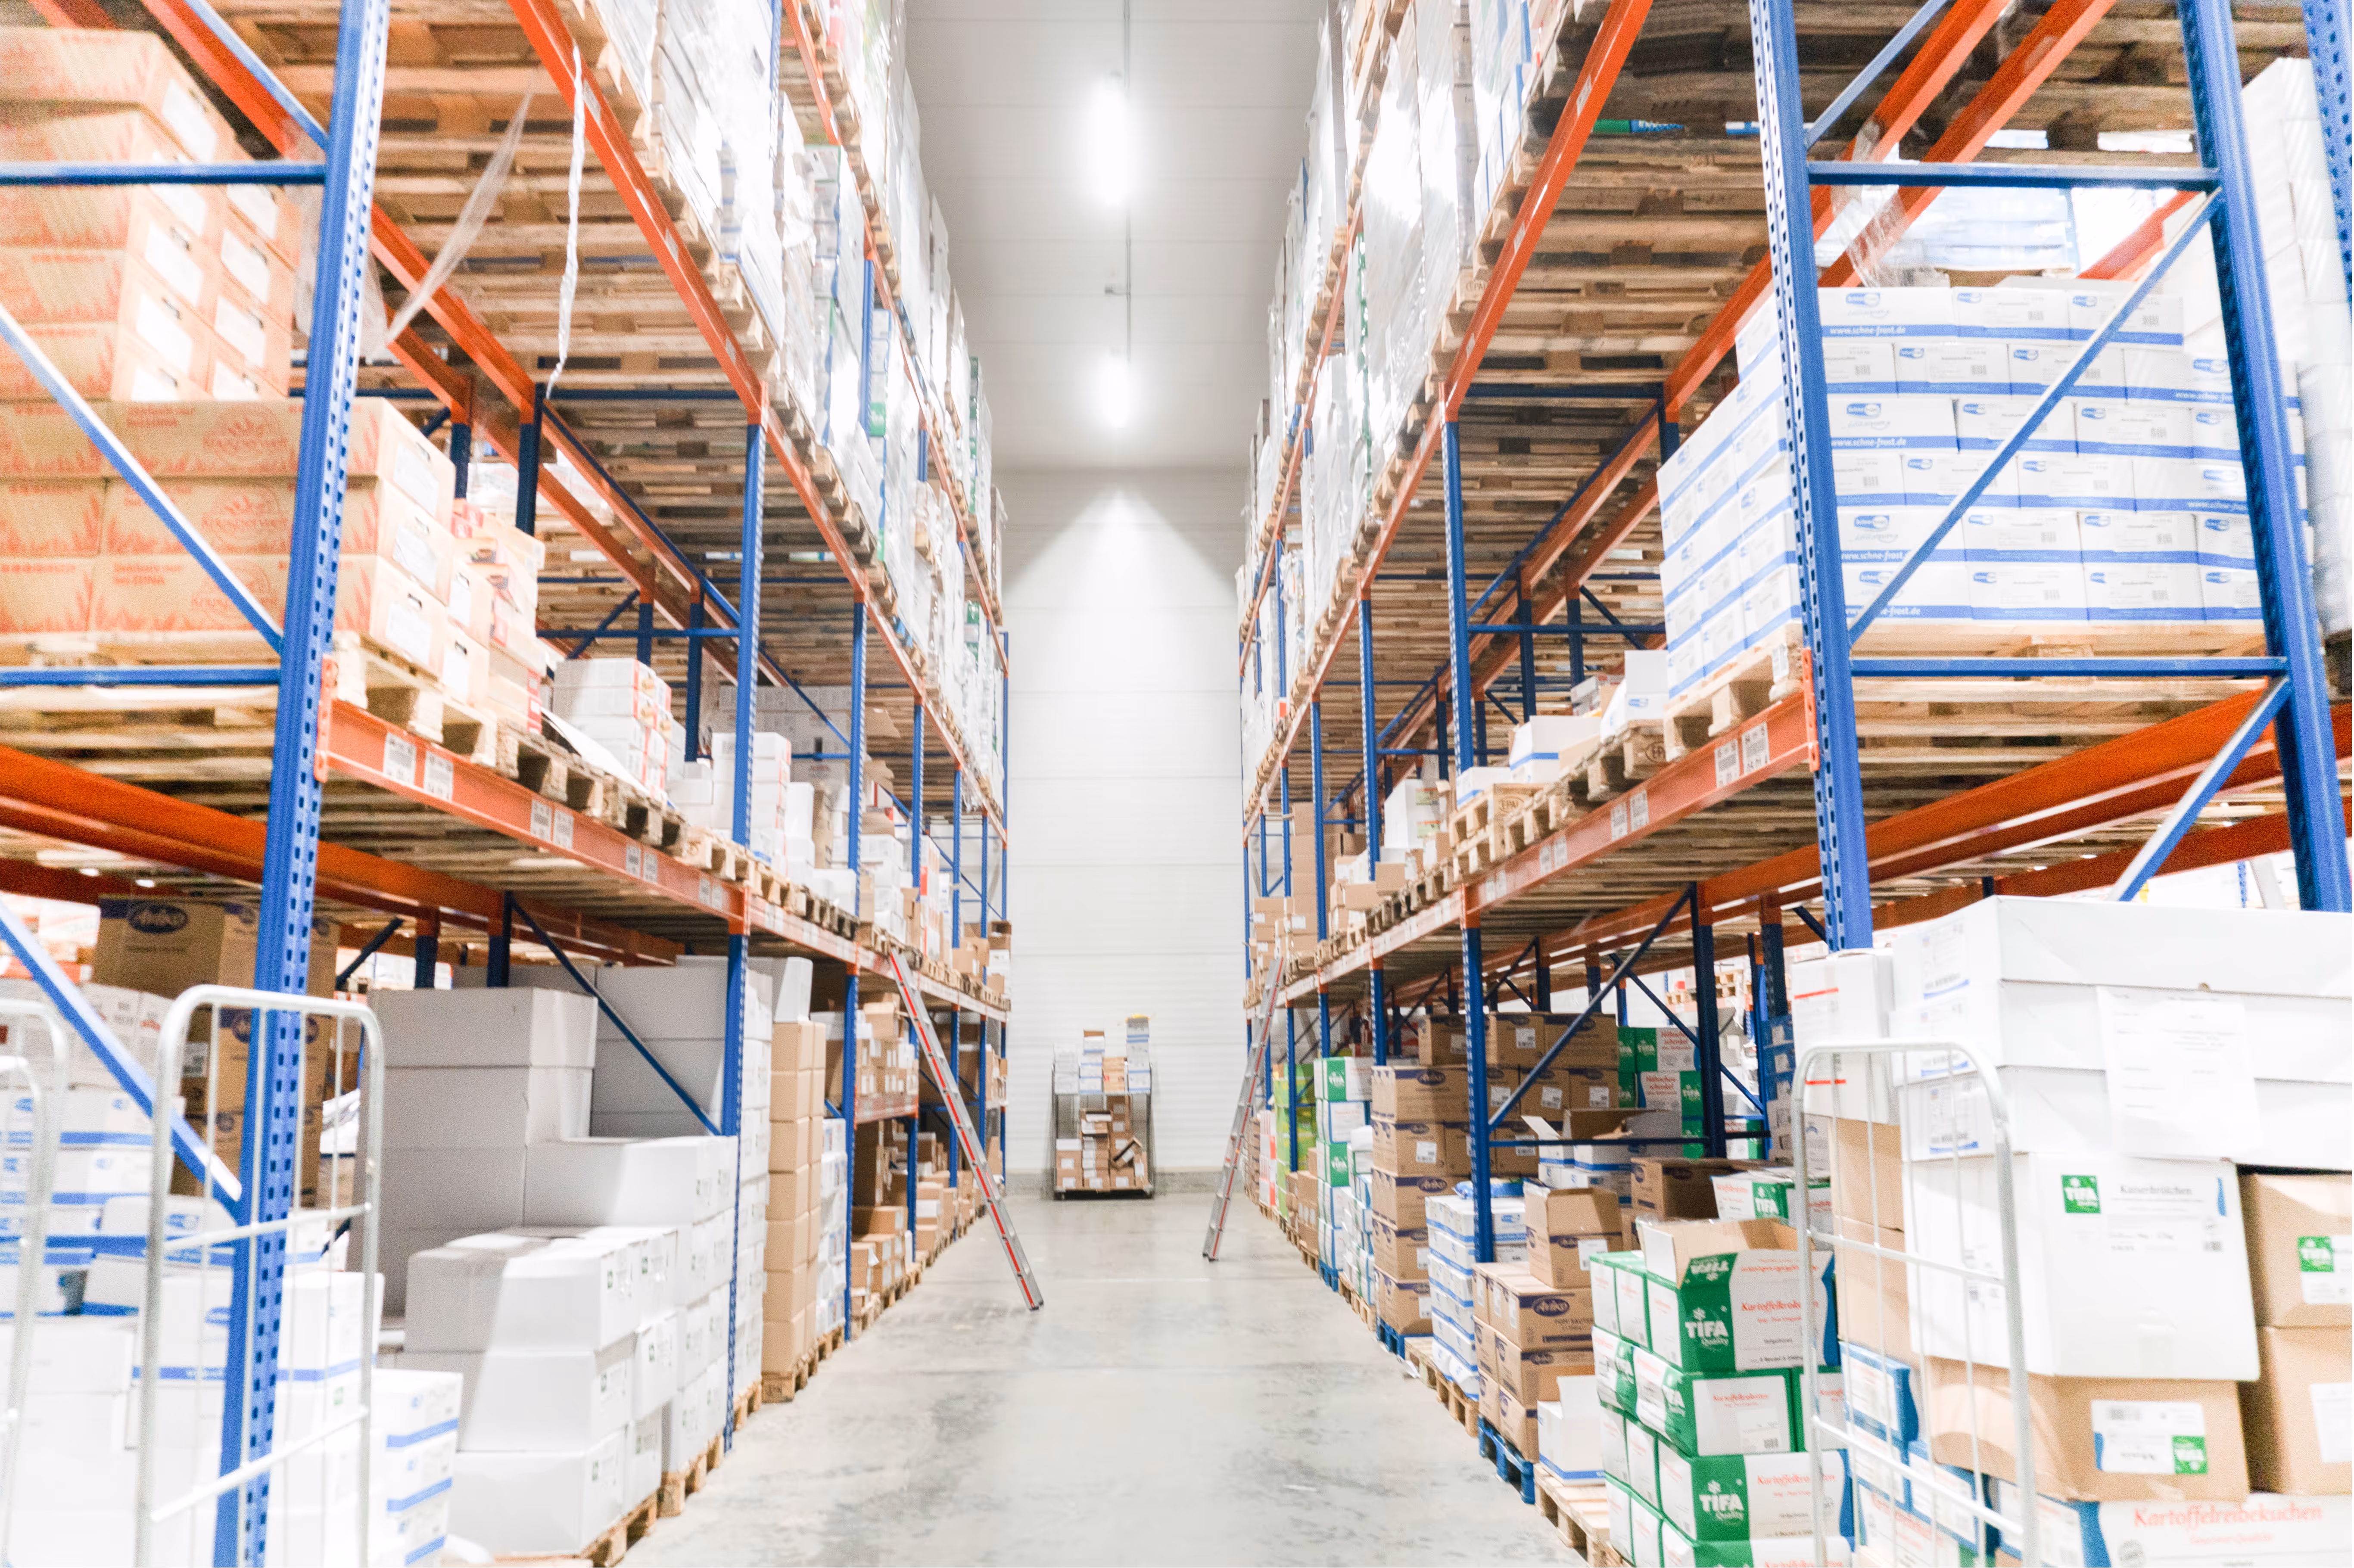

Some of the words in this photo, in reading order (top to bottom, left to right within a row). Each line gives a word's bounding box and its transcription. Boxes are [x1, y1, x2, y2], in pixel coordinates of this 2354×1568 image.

[1830, 326, 1906, 336] www.schne-frost.de
[1685, 1321, 1729, 1339] TIFA
[1699, 1493, 1744, 1512] TIFA
[2134, 1501, 2323, 1530] Kartoffelreibekuchen
